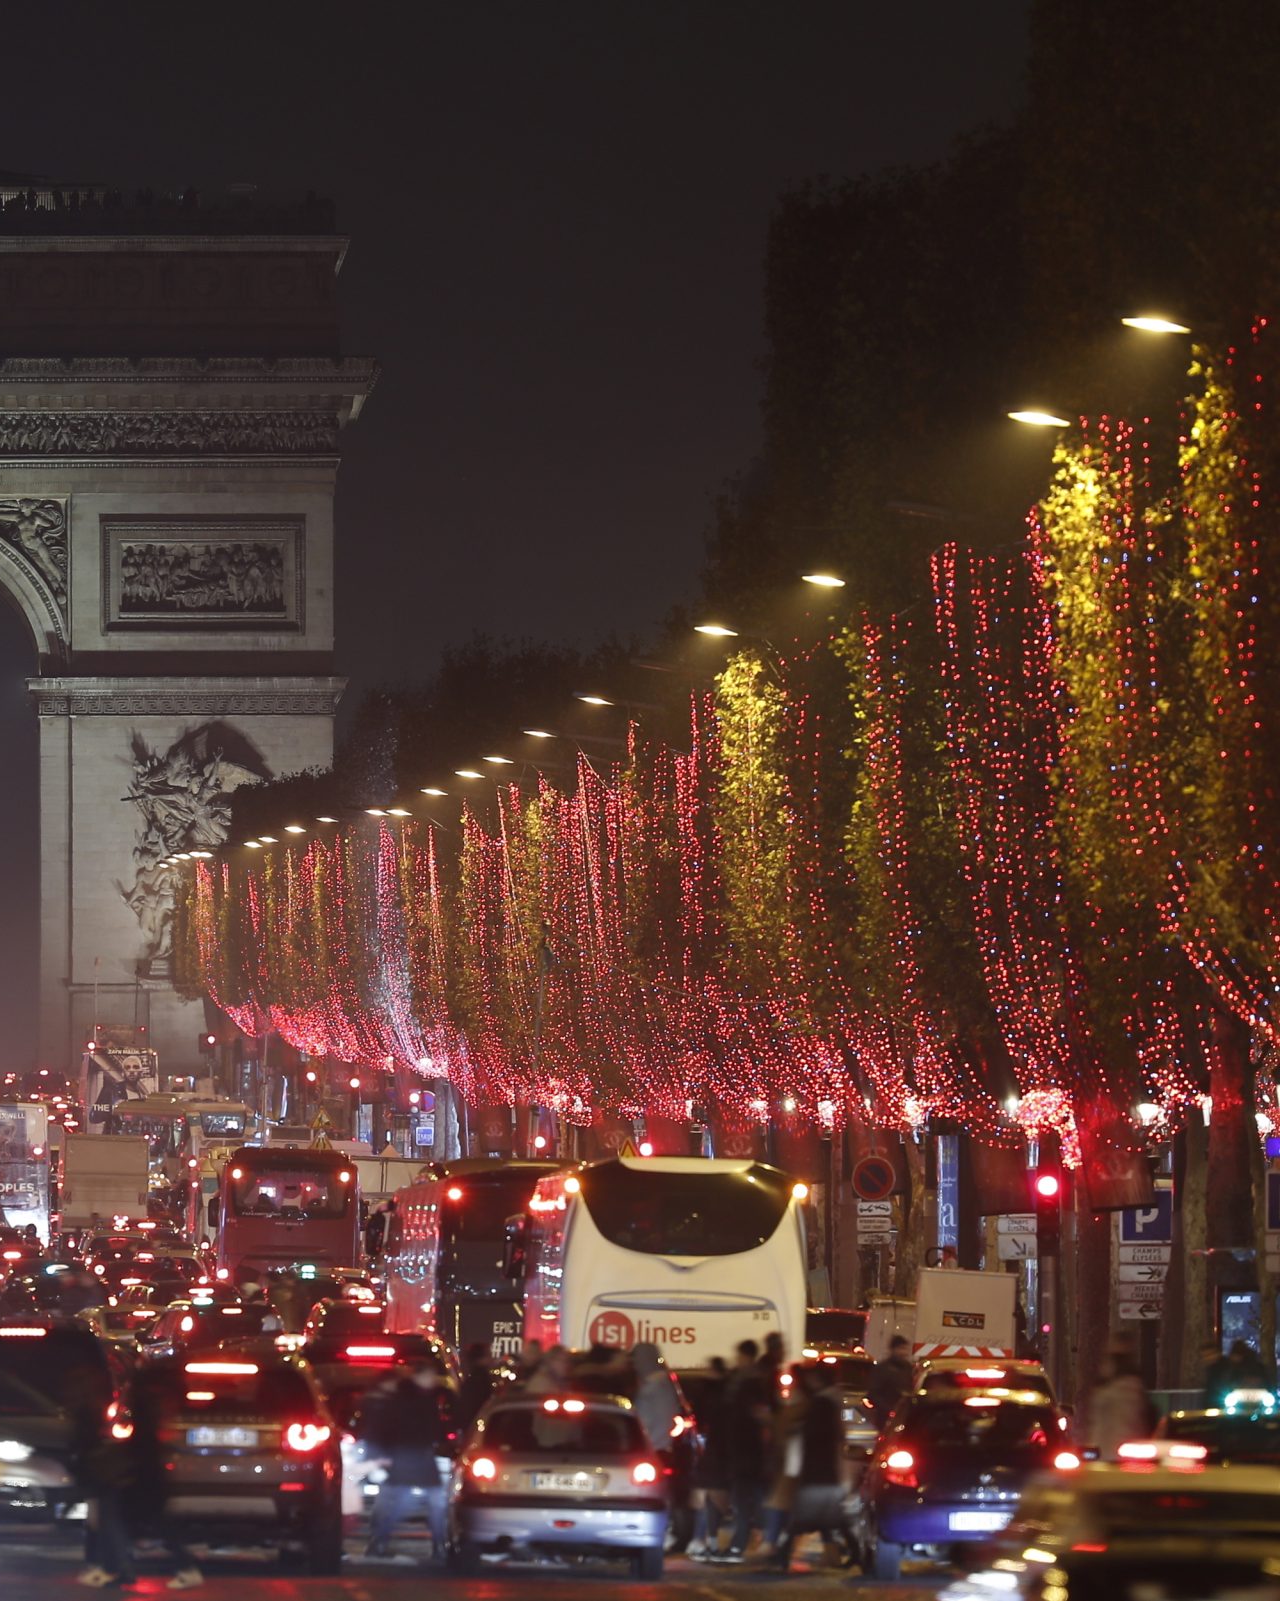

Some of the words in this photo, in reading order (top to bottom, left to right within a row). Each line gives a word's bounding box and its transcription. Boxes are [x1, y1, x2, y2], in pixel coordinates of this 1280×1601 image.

[93, 1104, 110, 1112] THE
[493, 1321, 514, 1333] EPIC
[515, 1321, 522, 1333] T
[491, 1337, 522, 1358] #TO
